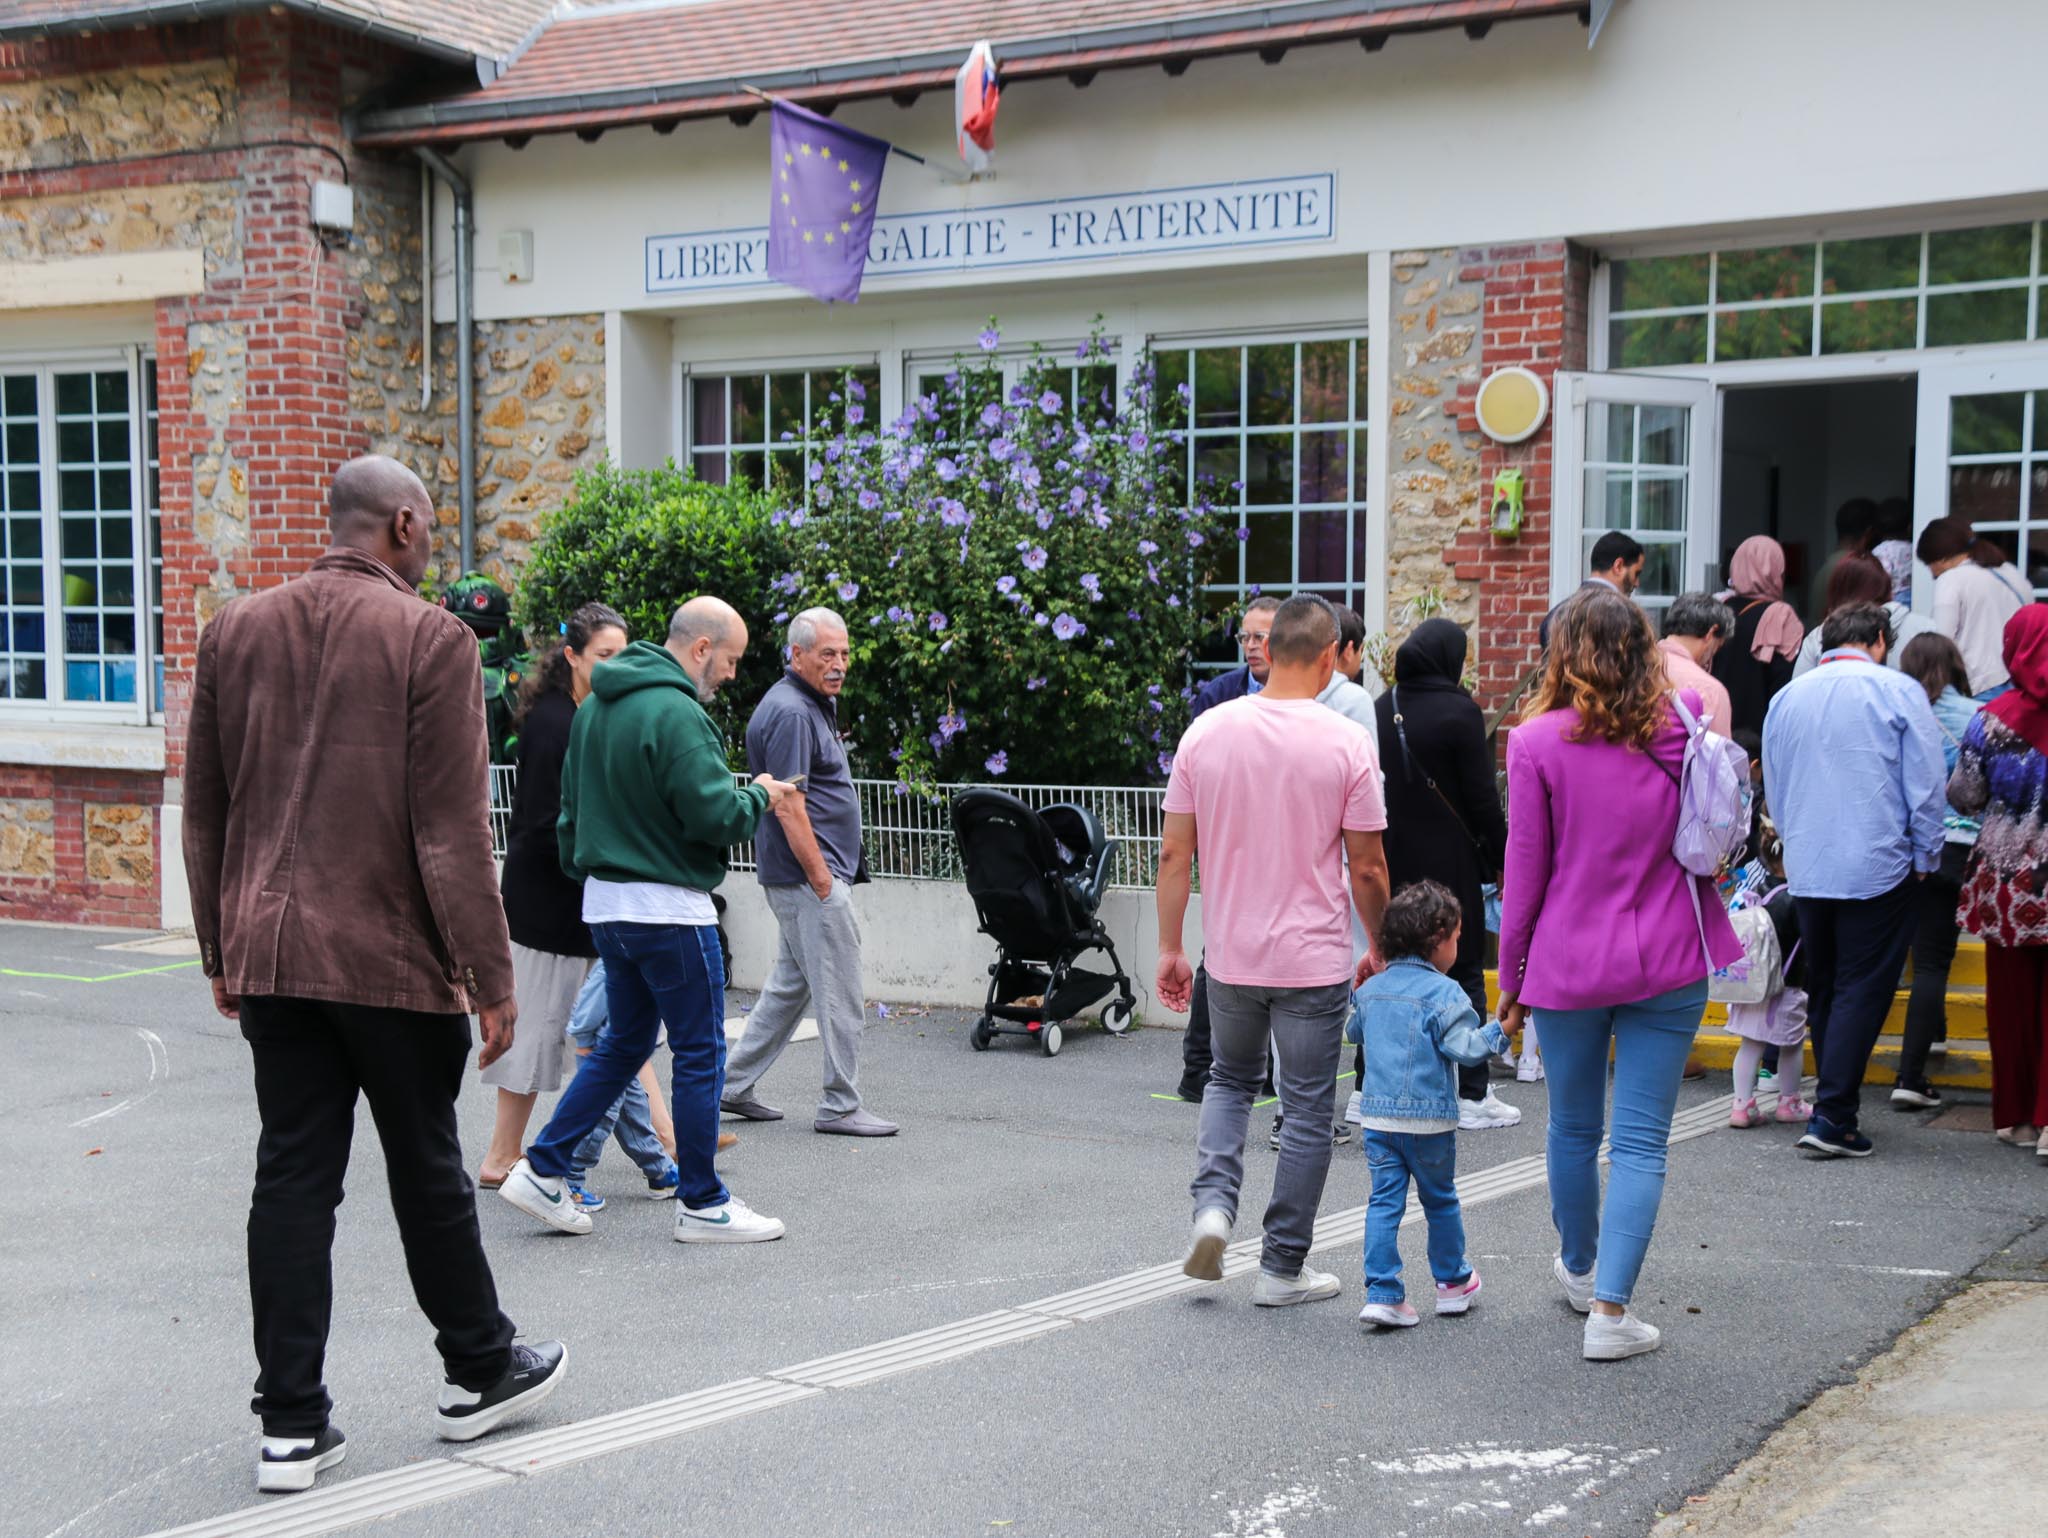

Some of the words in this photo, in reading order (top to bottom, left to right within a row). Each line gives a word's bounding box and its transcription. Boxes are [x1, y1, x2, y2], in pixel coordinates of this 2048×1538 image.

[655, 239, 769, 281] LIBERT
[867, 218, 1007, 264] GALITE
[1048, 188, 1320, 250] FRATERNITE
